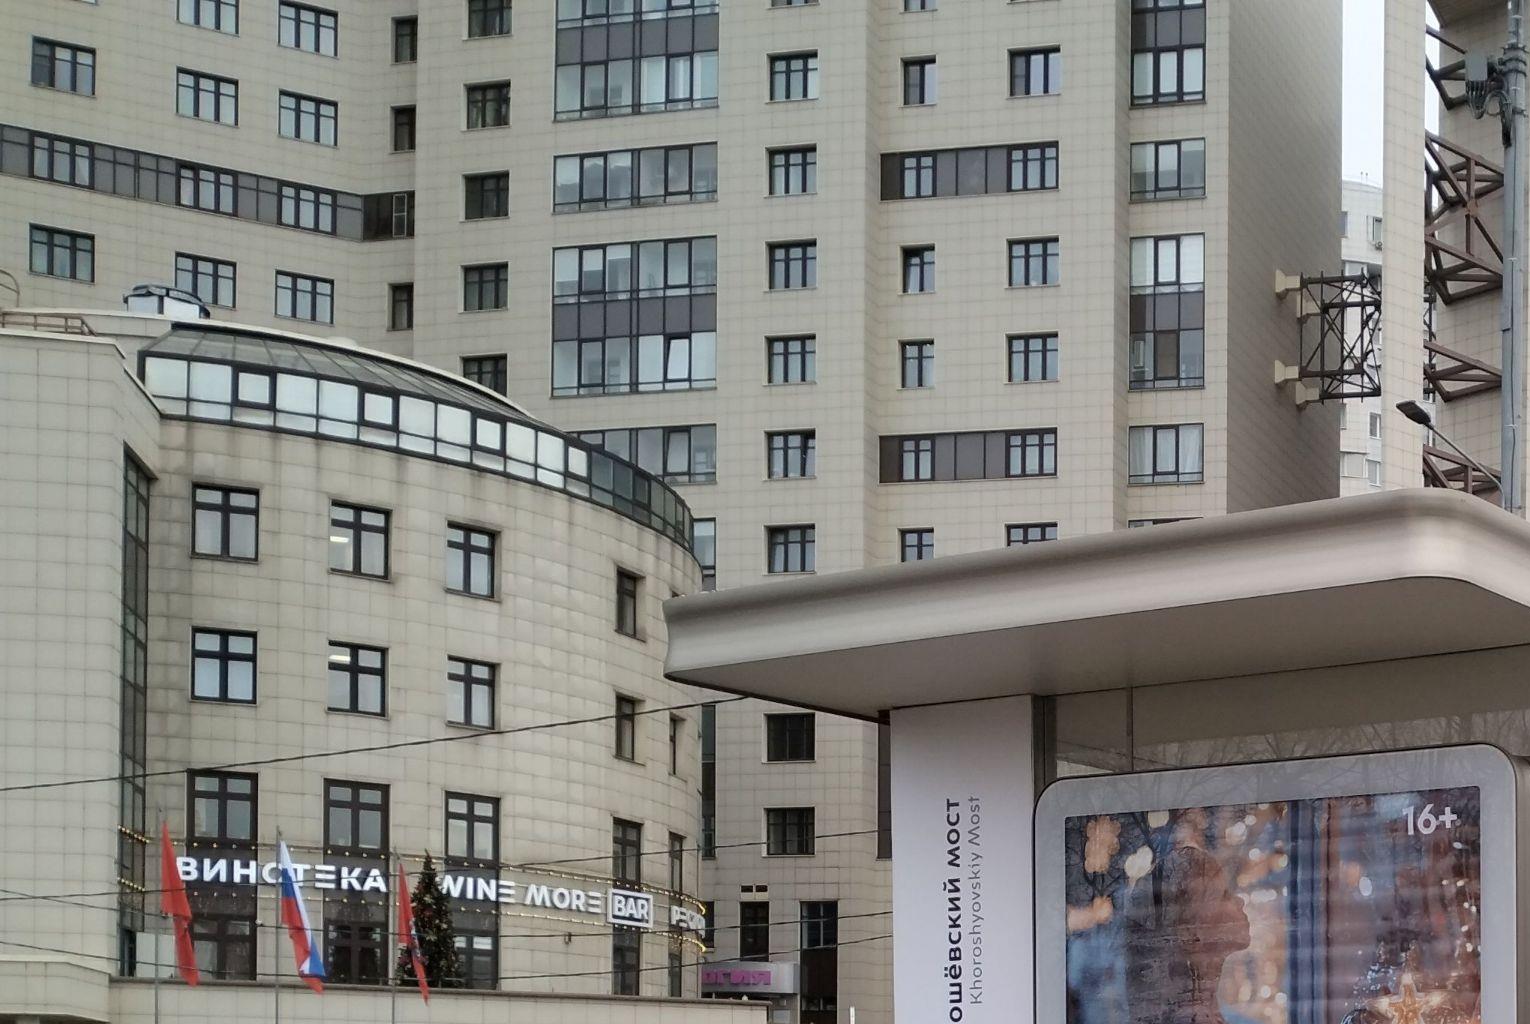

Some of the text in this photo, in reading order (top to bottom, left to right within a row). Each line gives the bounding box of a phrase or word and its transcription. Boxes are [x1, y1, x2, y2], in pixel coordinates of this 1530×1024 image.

[946, 798, 962, 868] мост
[1402, 803, 1458, 836] 16+
[176, 856, 389, 893] ВИНОТЕКА
[525, 884, 602, 914] MORE
[614, 893, 650, 920] BAR
[968, 796, 984, 1005] Khoroshyovskiy Most
